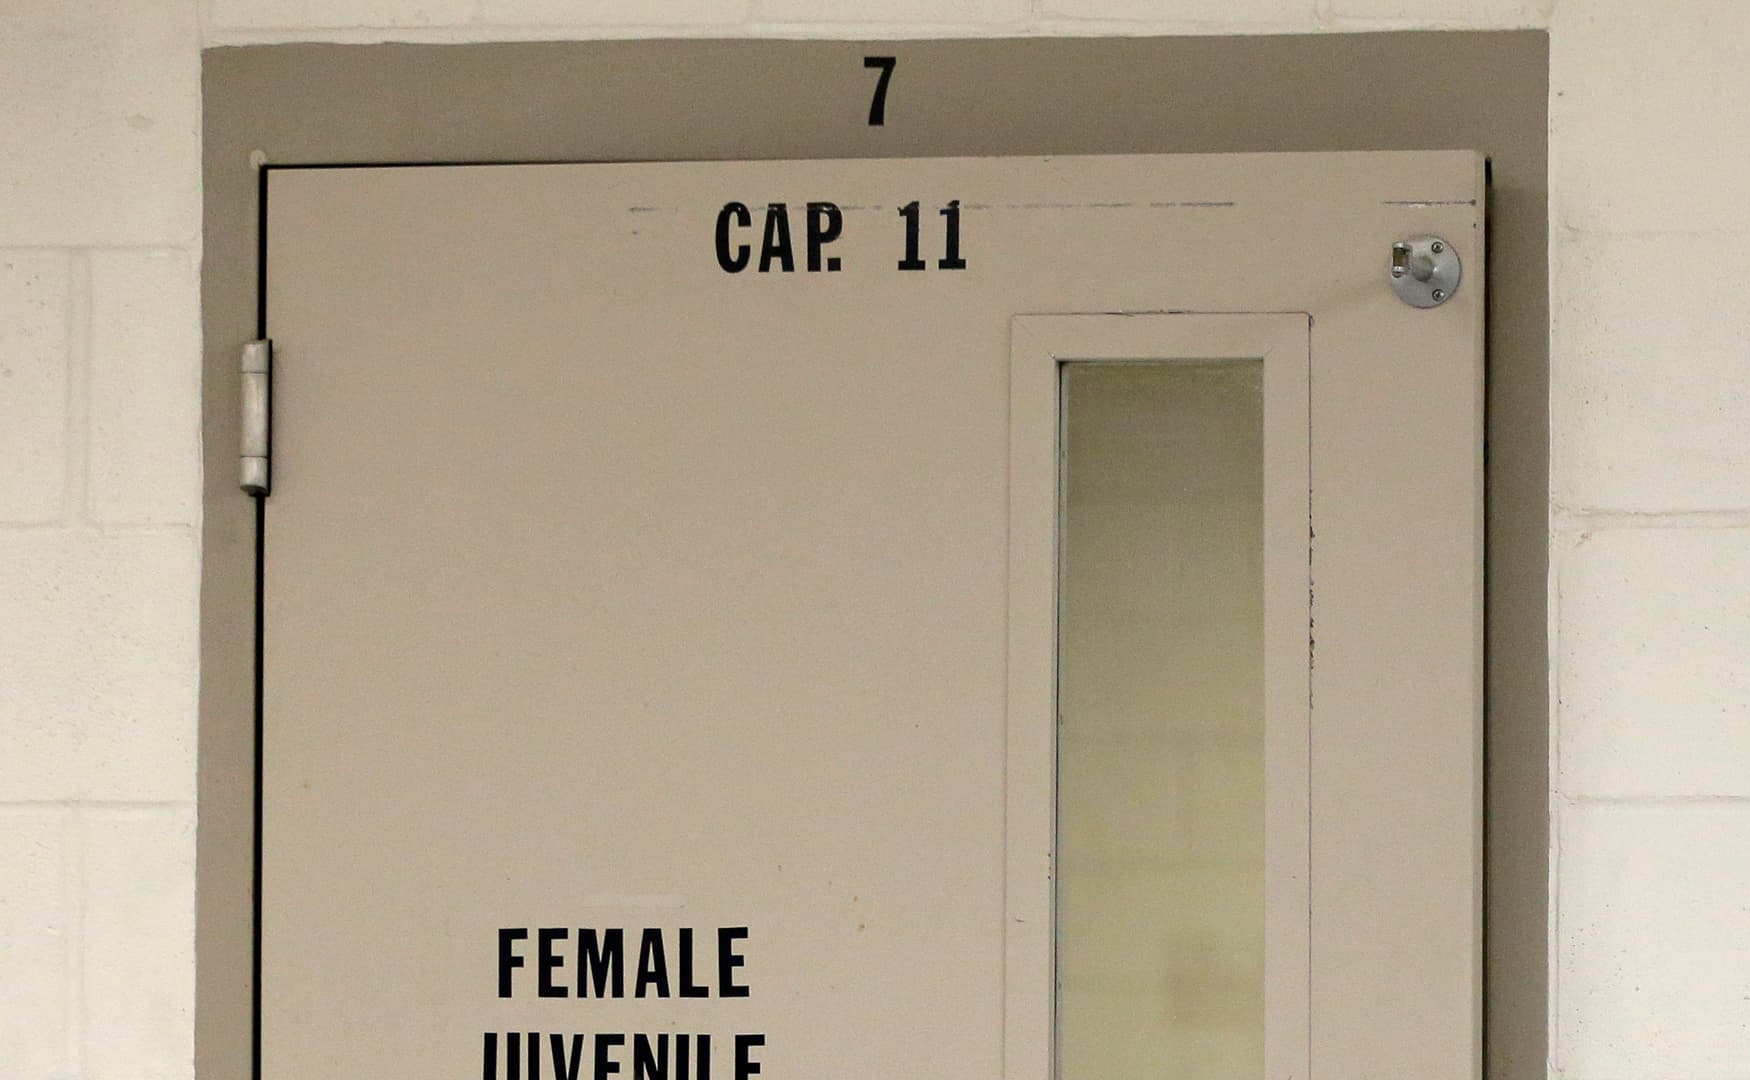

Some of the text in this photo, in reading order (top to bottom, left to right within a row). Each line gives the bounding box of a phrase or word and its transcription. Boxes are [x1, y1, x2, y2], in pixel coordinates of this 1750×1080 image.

[863, 56, 897, 126] 7
[715, 200, 967, 273] CAP. 11
[498, 926, 750, 999] FEMALE
